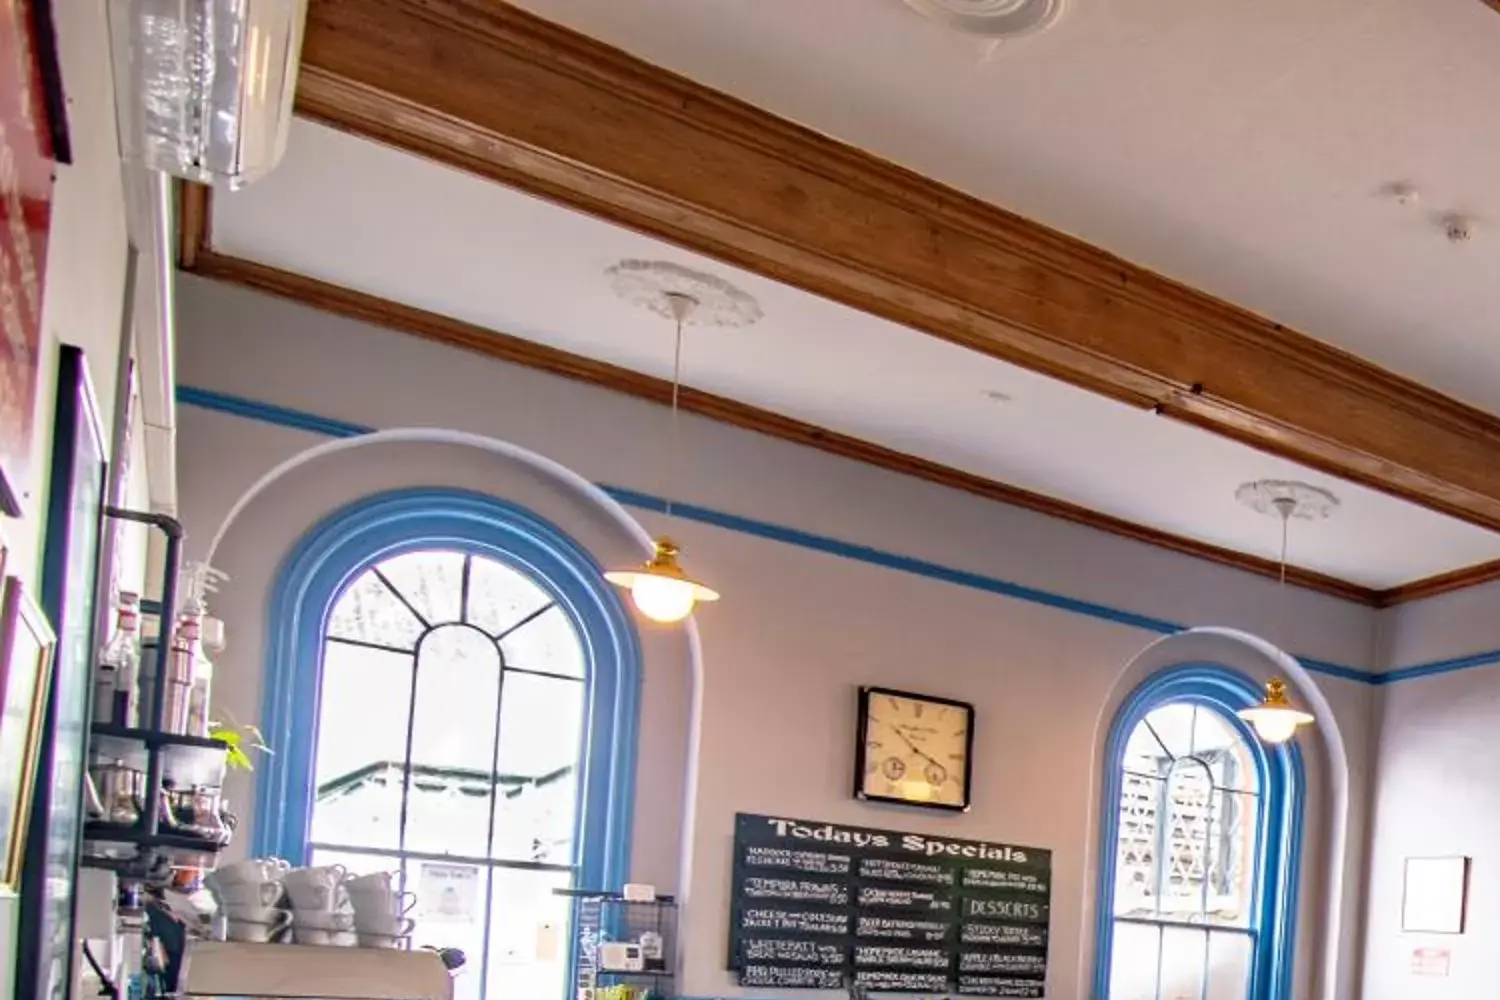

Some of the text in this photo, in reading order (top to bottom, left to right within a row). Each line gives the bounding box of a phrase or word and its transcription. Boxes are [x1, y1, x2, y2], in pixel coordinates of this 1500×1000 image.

[768, 818, 1030, 863] Todays Specials
[970, 899, 1040, 920] DESSERTS
